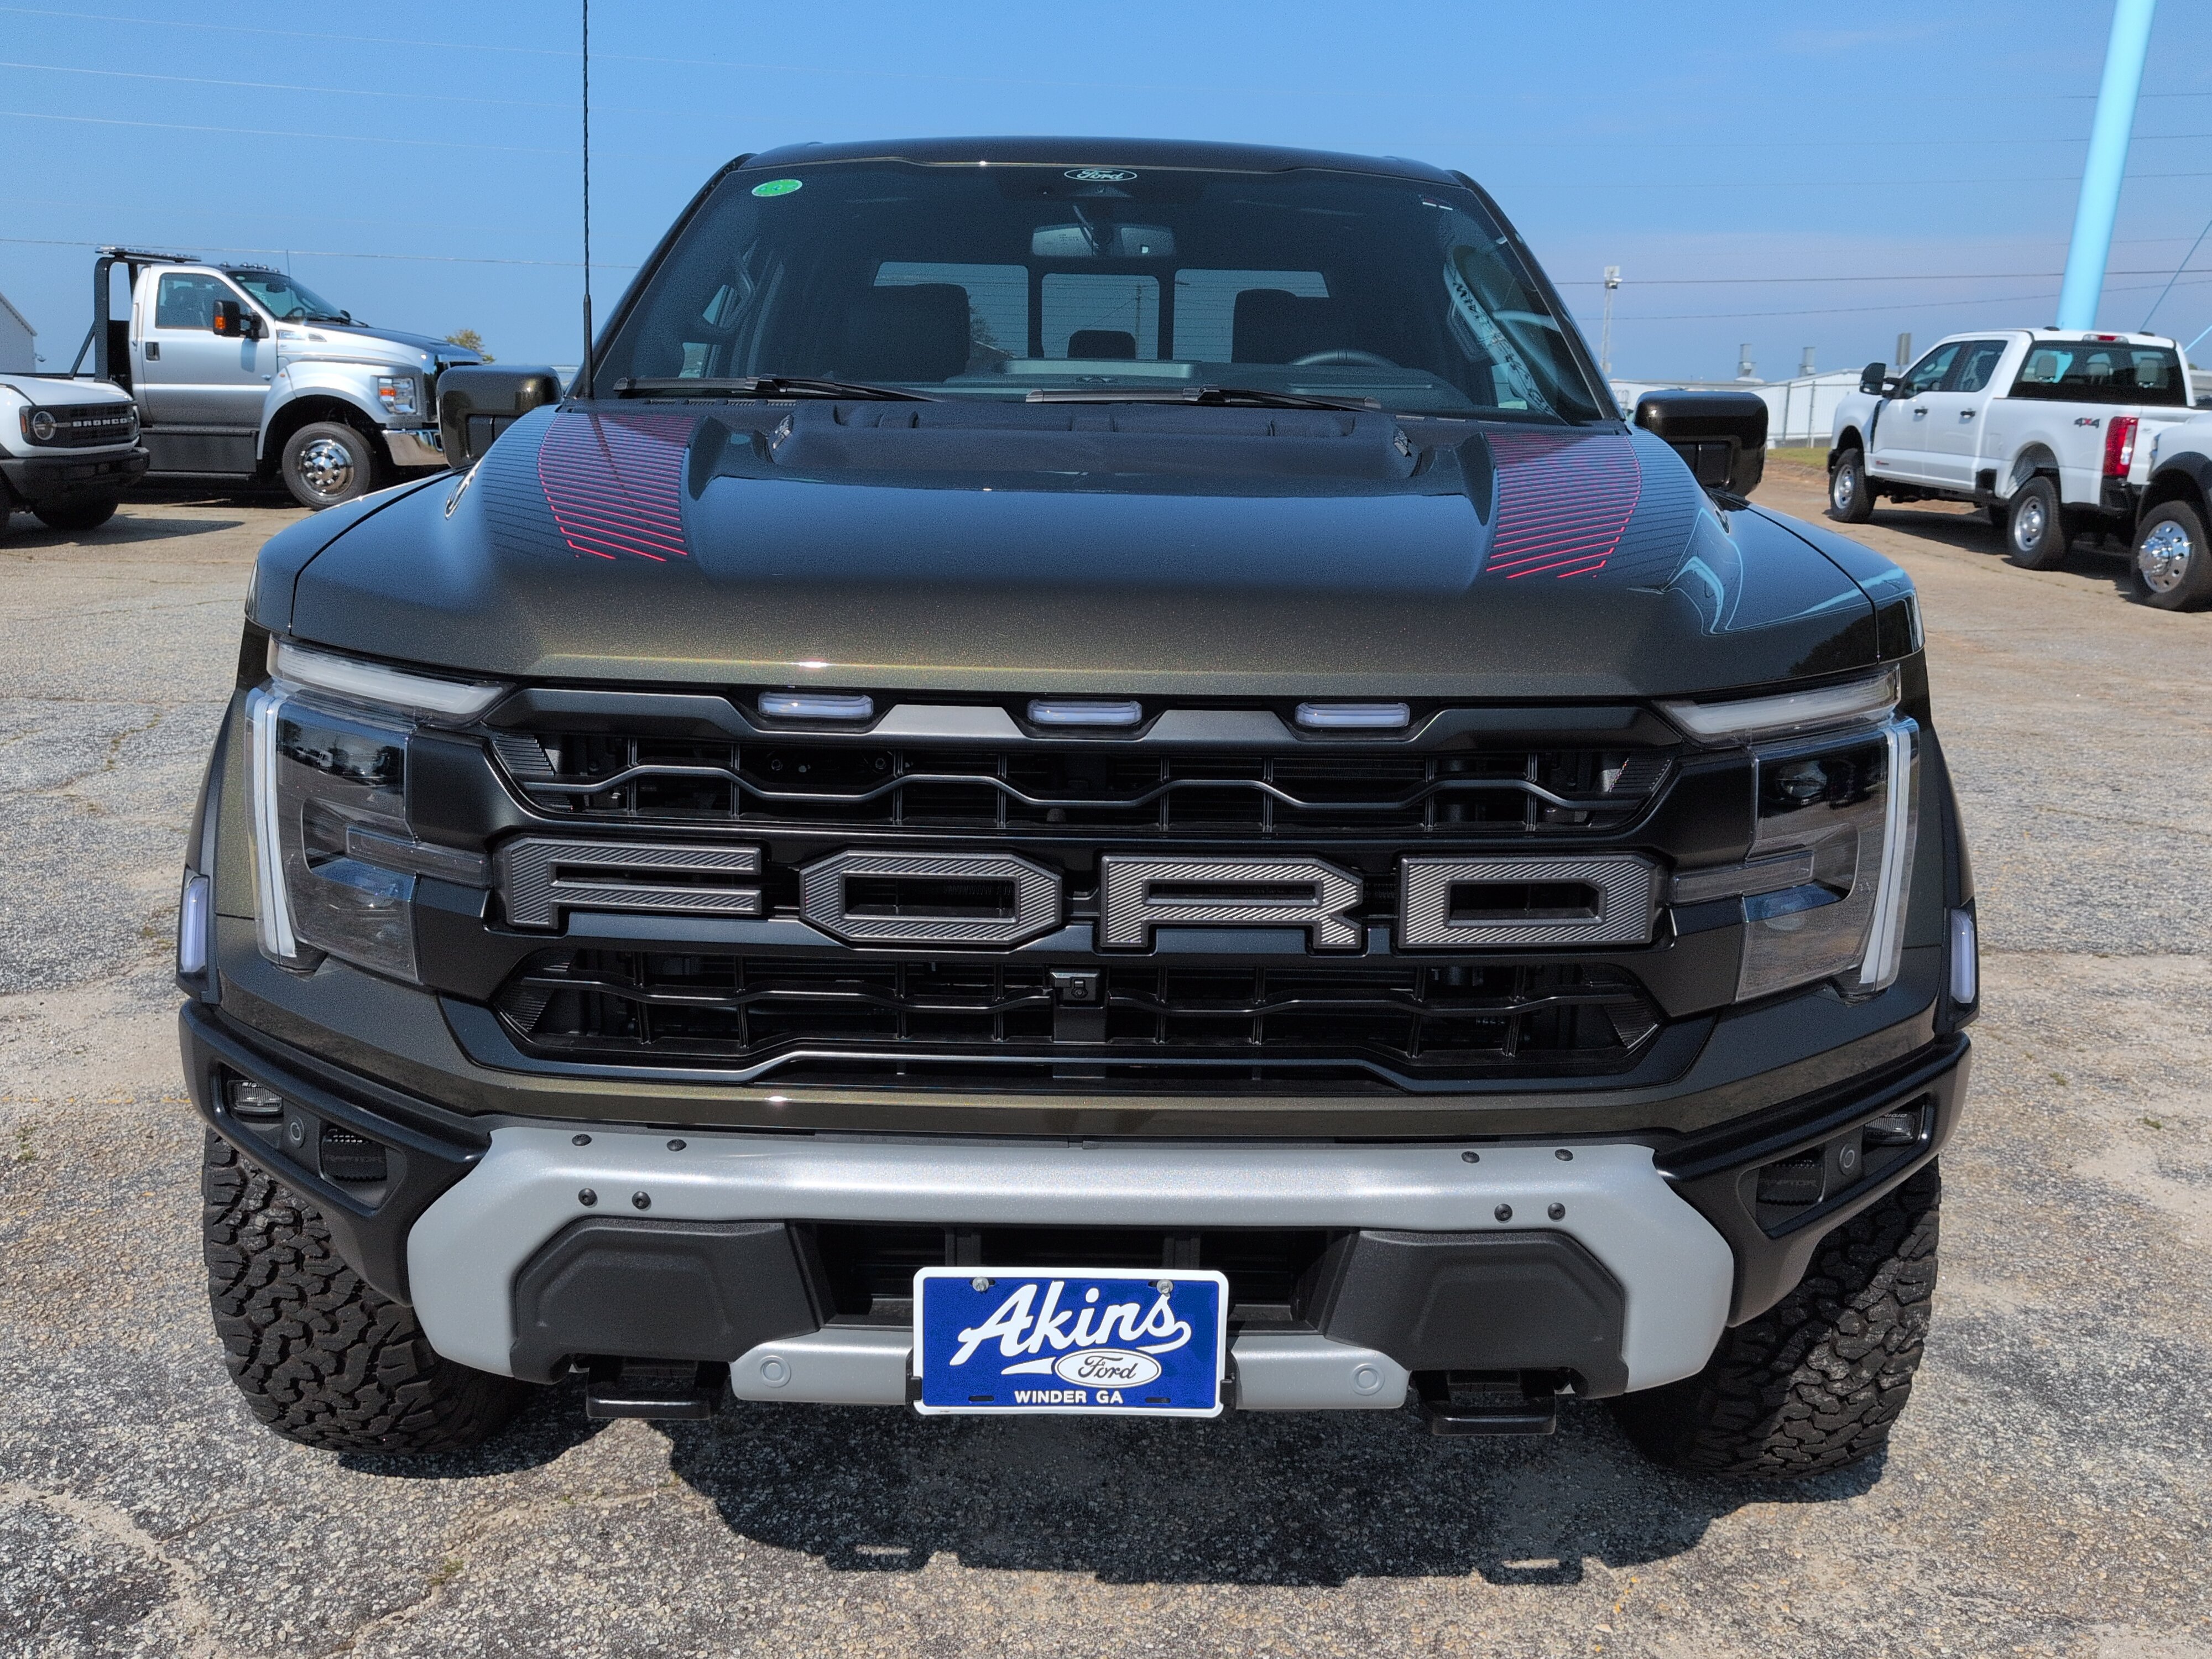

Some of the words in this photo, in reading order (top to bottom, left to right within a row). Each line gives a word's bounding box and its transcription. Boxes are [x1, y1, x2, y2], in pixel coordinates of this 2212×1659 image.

[1076, 170, 1125, 179] Ford
[72, 418, 127, 427] BRONCO
[500, 835, 1660, 952] FORD
[948, 1280, 1192, 1366] Akins
[1078, 1355, 1139, 1379] Ford
[1014, 1390, 1087, 1404] WINDER
[1095, 1390, 1124, 1404] GA
